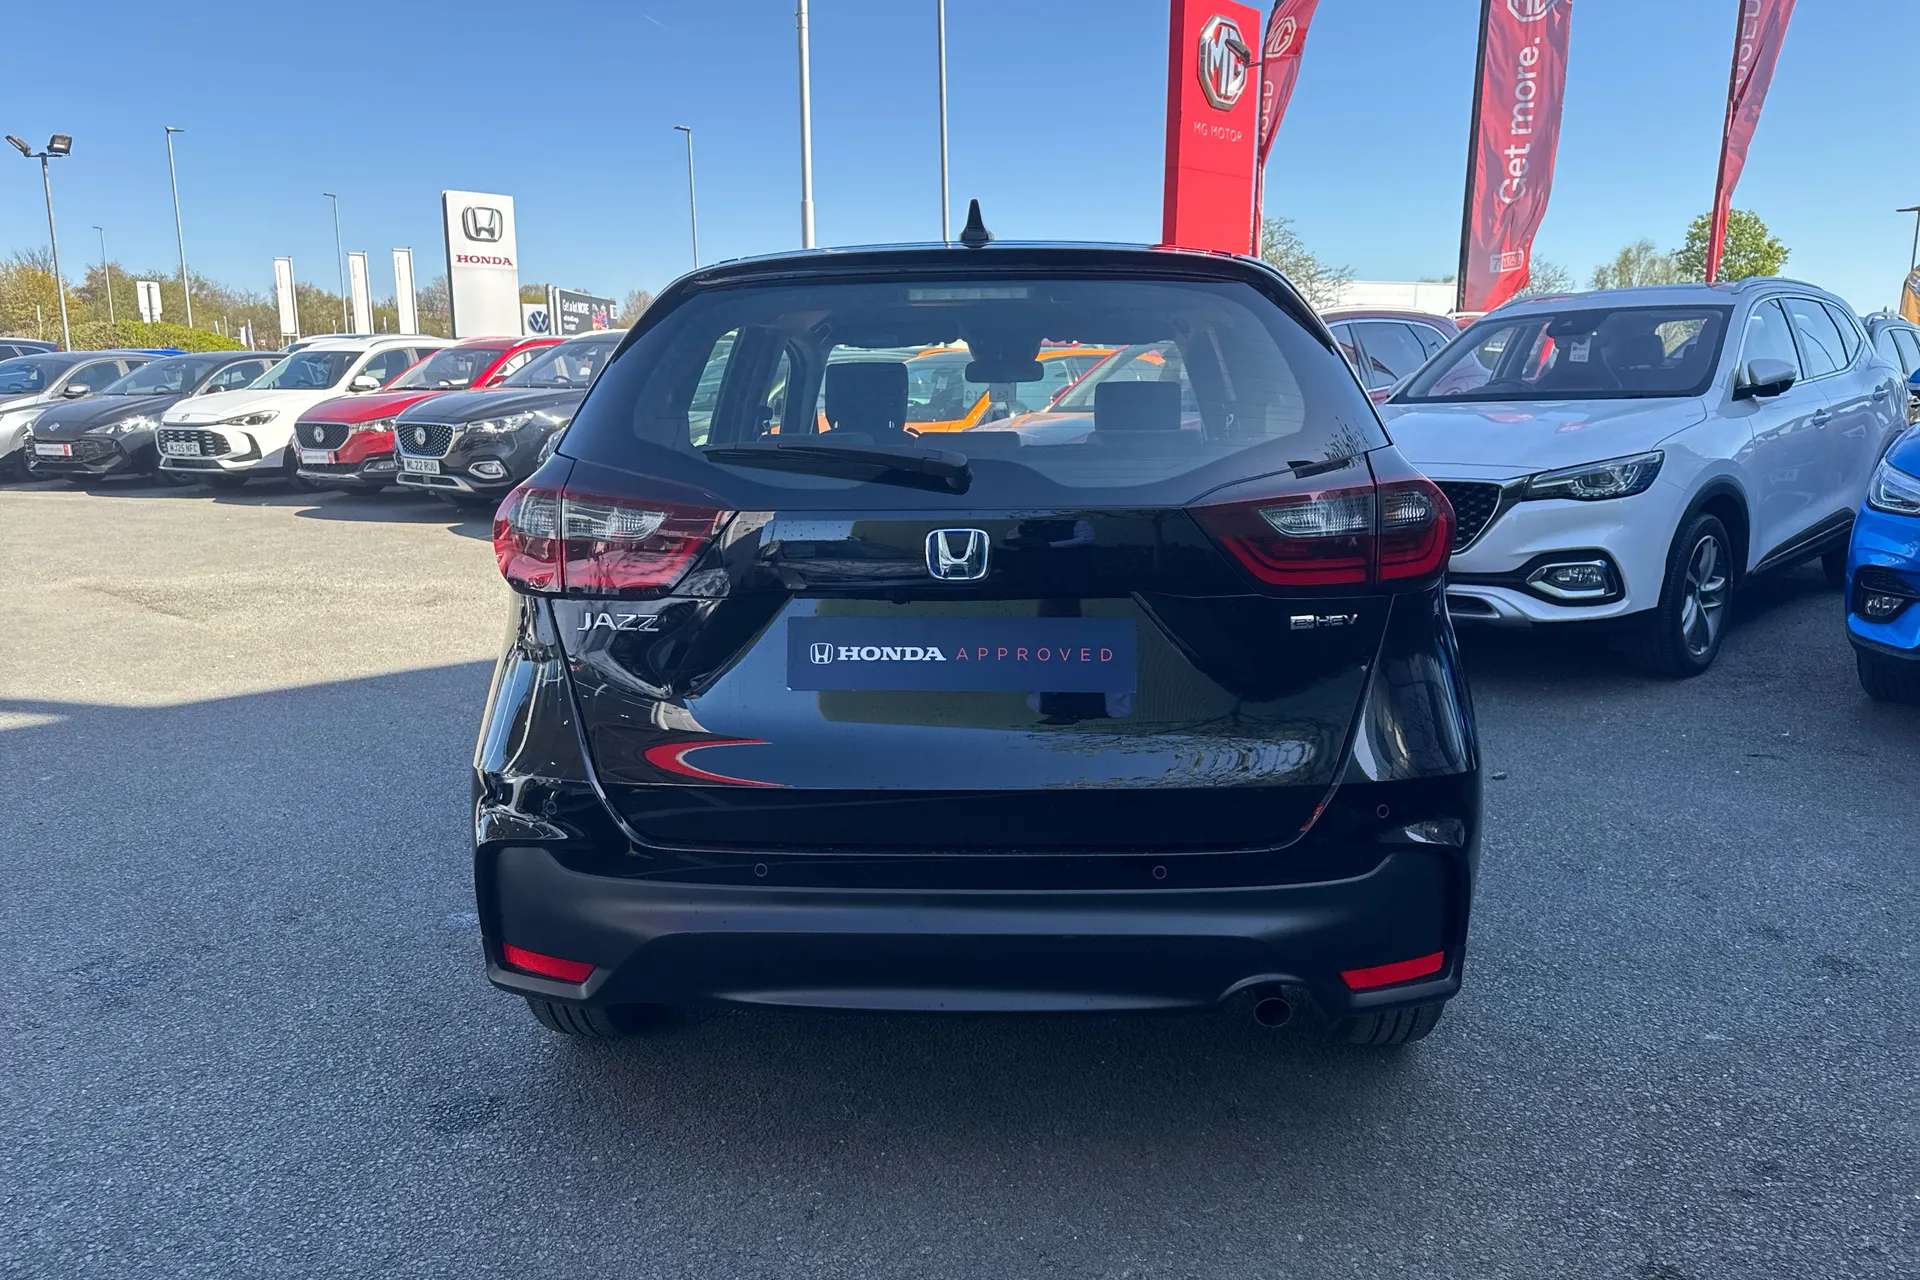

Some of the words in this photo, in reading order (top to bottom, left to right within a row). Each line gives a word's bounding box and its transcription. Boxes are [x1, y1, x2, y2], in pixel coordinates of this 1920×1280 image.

[1511, 36, 1541, 135] more.
[1193, 121, 1208, 136] MG
[1211, 126, 1243, 142] MOTOR
[1500, 143, 1530, 205] Get
[456, 254, 513, 266] HONDA
[576, 612, 660, 632] JAZZ
[837, 646, 947, 661] HONDA
[955, 648, 1113, 663] APPROVED
